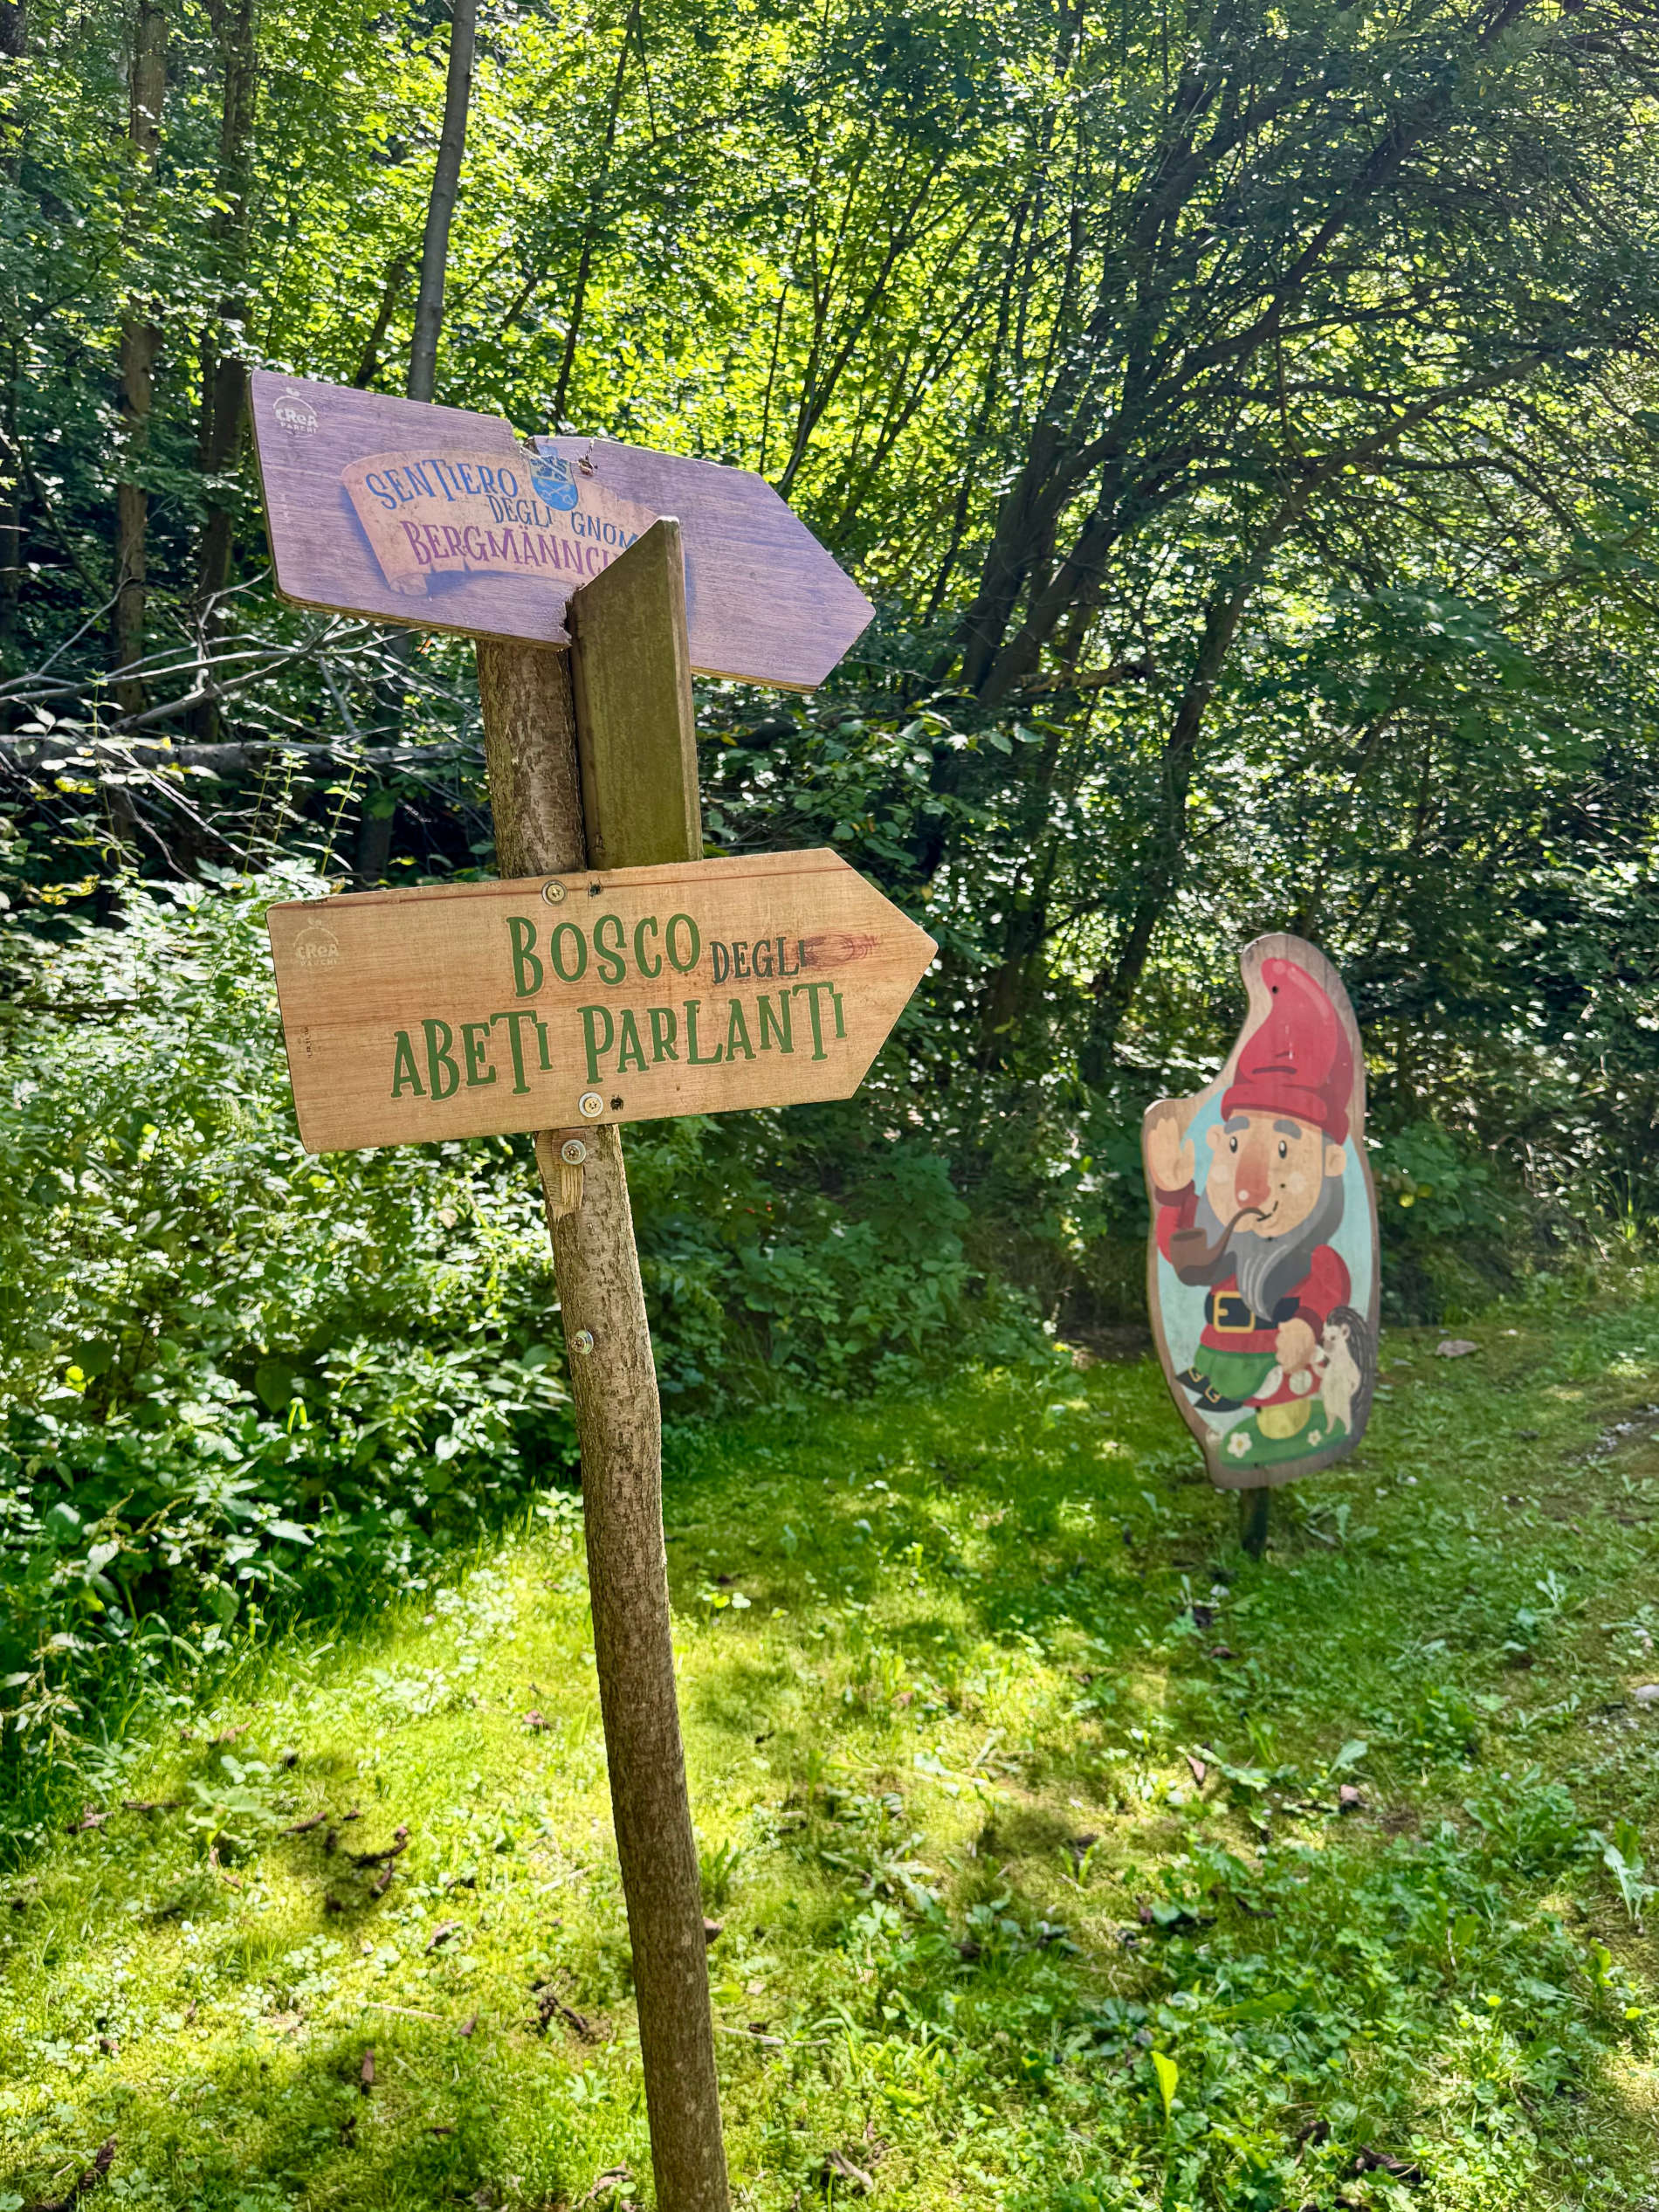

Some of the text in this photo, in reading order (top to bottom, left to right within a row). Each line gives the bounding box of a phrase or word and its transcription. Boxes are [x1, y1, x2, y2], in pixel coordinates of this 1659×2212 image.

[365, 458, 518, 510] SENTIERO
[486, 494, 554, 527] DEGLI
[506, 913, 808, 998] BOSCO DEGLI
[391, 981, 847, 1101] ABETI PARLANTI
